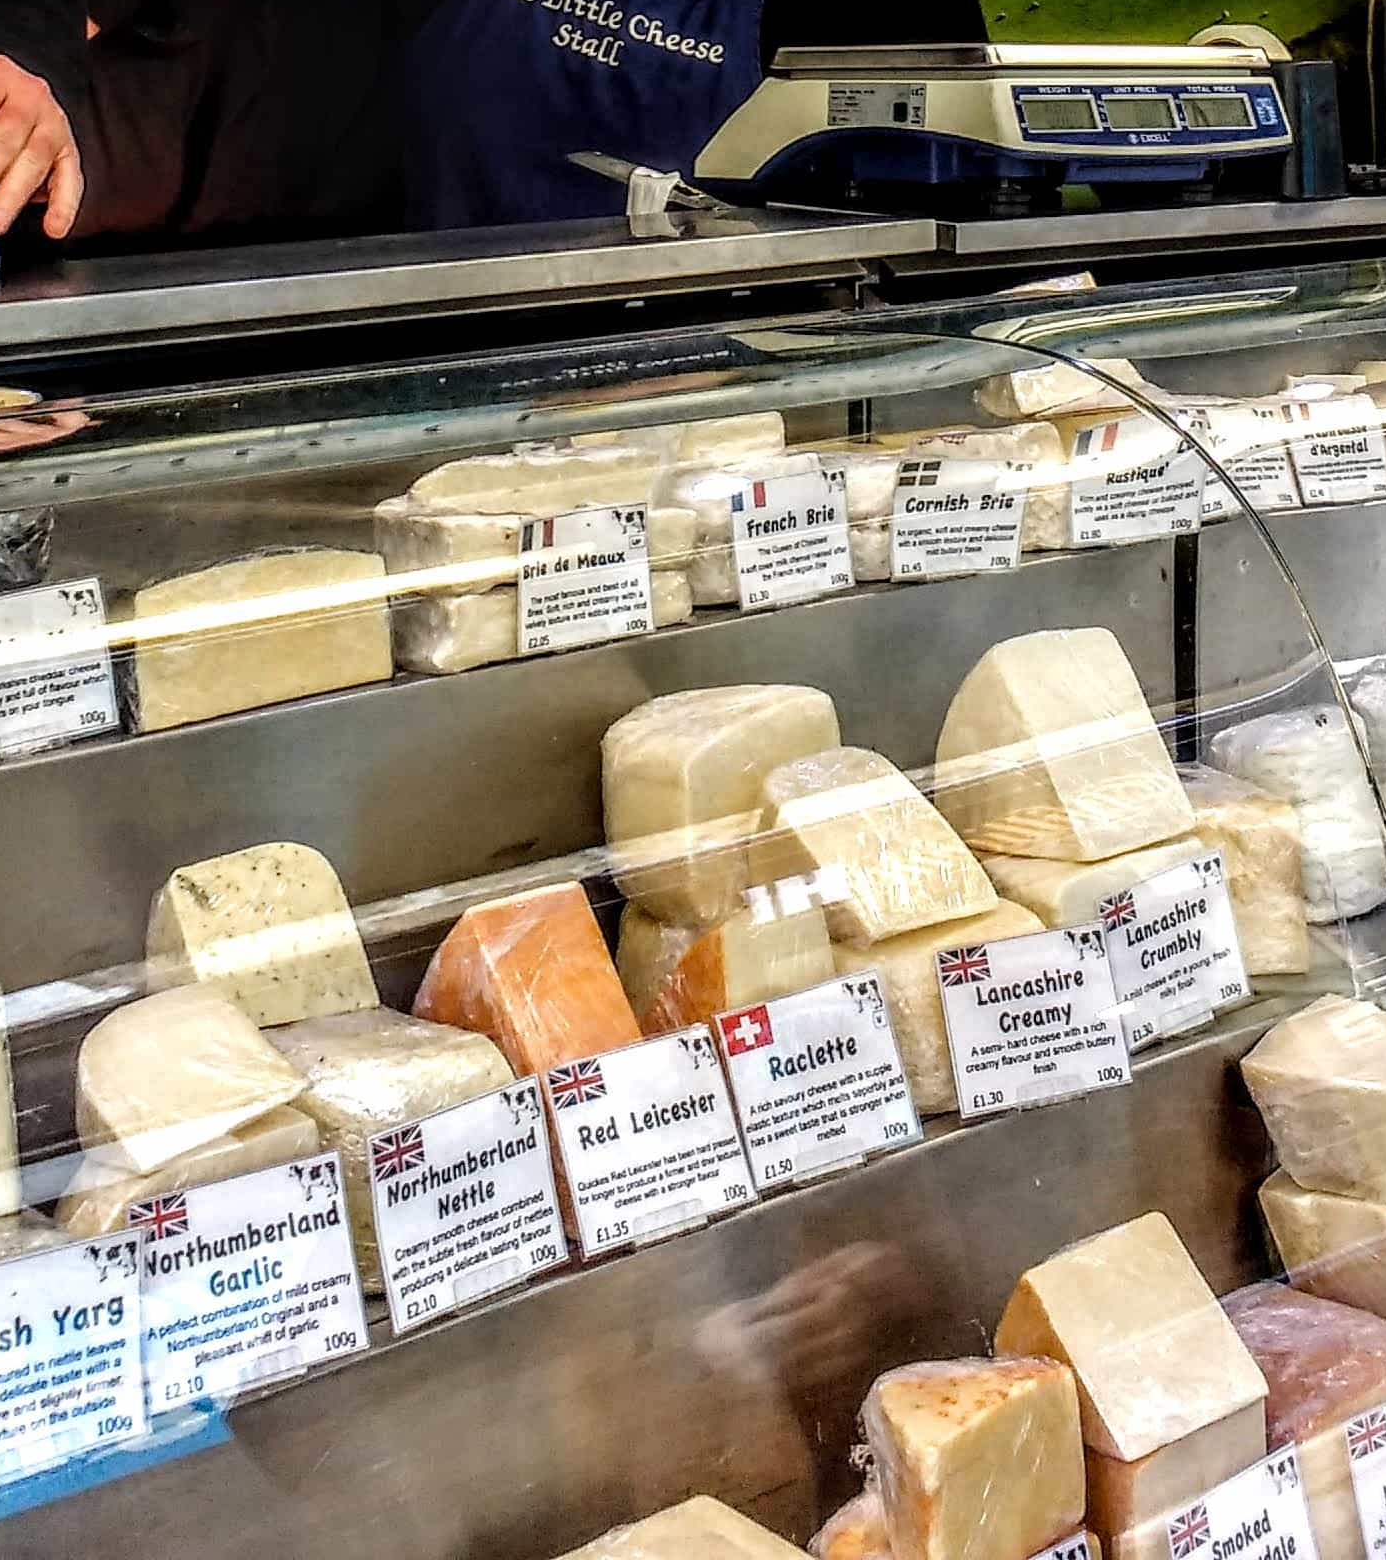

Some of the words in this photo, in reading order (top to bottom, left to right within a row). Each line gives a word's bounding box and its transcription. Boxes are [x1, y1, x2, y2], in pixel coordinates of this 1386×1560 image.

[553, 24, 625, 66] Stall
[628, 15, 724, 64] Cheese
[746, 510, 797, 538] French
[806, 504, 835, 526] Brie
[905, 493, 969, 514] Cornish
[522, 561, 548, 581] Brie
[553, 556, 570, 573] de
[577, 551, 626, 570] Meaux
[79, 710, 108, 730] 100g
[1125, 898, 1207, 948] Lancashire
[1140, 929, 1201, 970] Crumbly
[975, 969, 1084, 1006] Lancashire
[1219, 983, 1243, 1000] 100g
[999, 1003, 1072, 1034] Creamy
[768, 1036, 857, 1081] Raclette
[965, 1059, 1000, 1074] creamy
[1001, 1052, 1032, 1066] flavour
[1034, 1046, 1051, 1060] and
[1052, 1040, 1086, 1056] smooth
[1085, 1035, 1116, 1049] buttery
[970, 1046, 980, 1058] A
[1006, 1036, 1029, 1050] hard
[1029, 1031, 1062, 1046] cheese
[1062, 1026, 1082, 1038] with
[1082, 1025, 1090, 1035] a
[973, 1090, 1004, 1109] £1.30
[1097, 1066, 1124, 1082] 100g
[577, 1116, 620, 1151] Red
[630, 1093, 715, 1134] Leicester
[387, 1126, 537, 1207] Northumberland
[764, 1158, 793, 1180] £1.50
[883, 1122, 909, 1140] 100g
[437, 1180, 495, 1220] Nettle
[596, 1220, 629, 1244] £1.35
[723, 1183, 748, 1202] 100g
[391, 1265, 411, 1282] with
[410, 1259, 427, 1273] the
[427, 1246, 455, 1266] subtle
[455, 1235, 480, 1253] fresh
[479, 1222, 511, 1243] flavour
[512, 1215, 523, 1230] of
[523, 1205, 554, 1225] nettles
[394, 1239, 430, 1262] Creamy
[431, 1223, 466, 1246] smooth
[466, 1210, 500, 1231] cheese
[500, 1189, 545, 1218] combined
[209, 1256, 283, 1297] Garlic
[399, 1269, 445, 1300] producing
[445, 1266, 453, 1277] a
[453, 1250, 489, 1273] delicate
[489, 1237, 520, 1257] lasting
[520, 1223, 552, 1244] flavour
[406, 1293, 438, 1321] £2.10
[530, 1244, 559, 1271] 100g
[52, 1295, 124, 1336] Yarg
[164, 1375, 205, 1401] £2.10
[324, 1331, 357, 1352] 100g
[97, 1415, 133, 1437] 100g
[1211, 1508, 1272, 1560] Smoked
